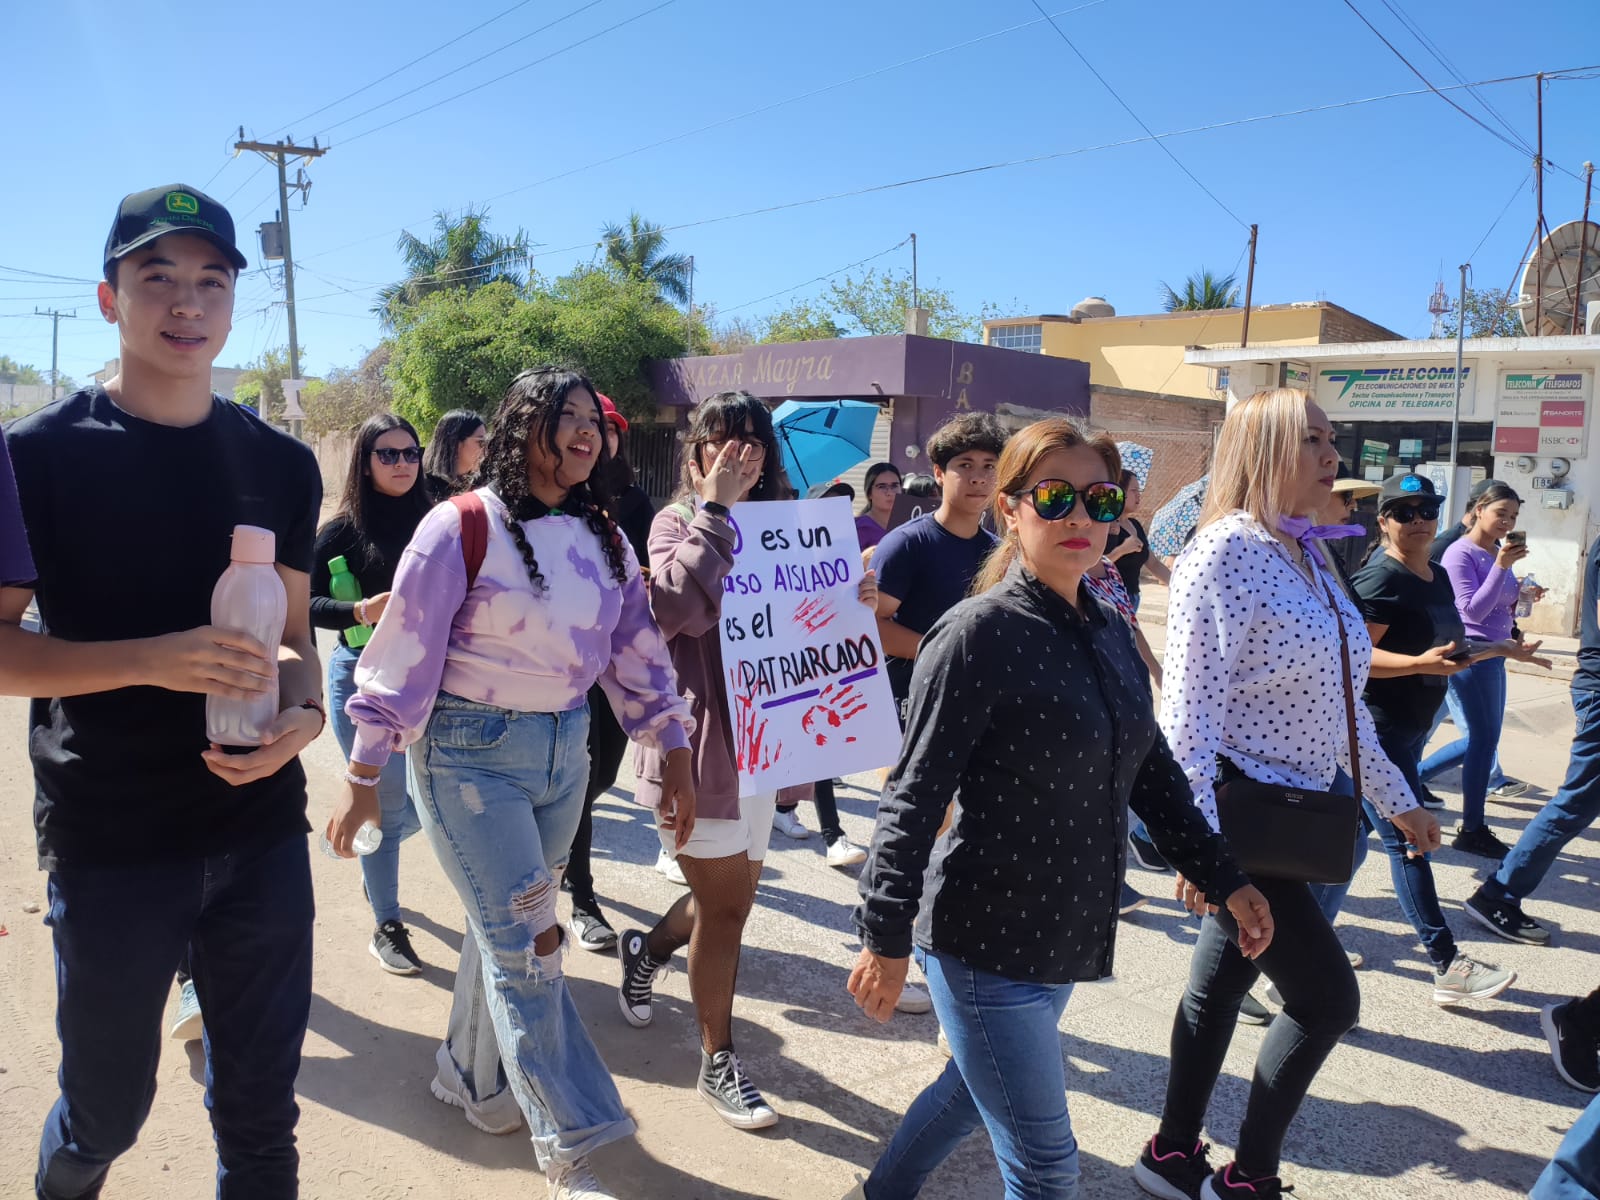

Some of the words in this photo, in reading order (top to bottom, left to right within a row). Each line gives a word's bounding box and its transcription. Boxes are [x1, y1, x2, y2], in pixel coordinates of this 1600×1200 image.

[752, 352, 834, 393] Mayra
[1373, 367, 1471, 381] TELECOMM
[1354, 382, 1427, 390] TELECOMUNICACIONES
[1544, 380, 1581, 389] TELEGRAFOS
[1424, 391, 1461, 400] Transport
[1349, 400, 1381, 408] OFICINA
[1401, 400, 1456, 408] TELEGRAFO
[1541, 436, 1565, 445] HSBC
[760, 528, 790, 551] es
[798, 526, 832, 550] un
[723, 572, 762, 595] aso
[774, 558, 850, 593] AISLADO
[725, 616, 746, 642] es
[751, 602, 774, 639] el
[741, 633, 878, 697] PATRIARCADO
